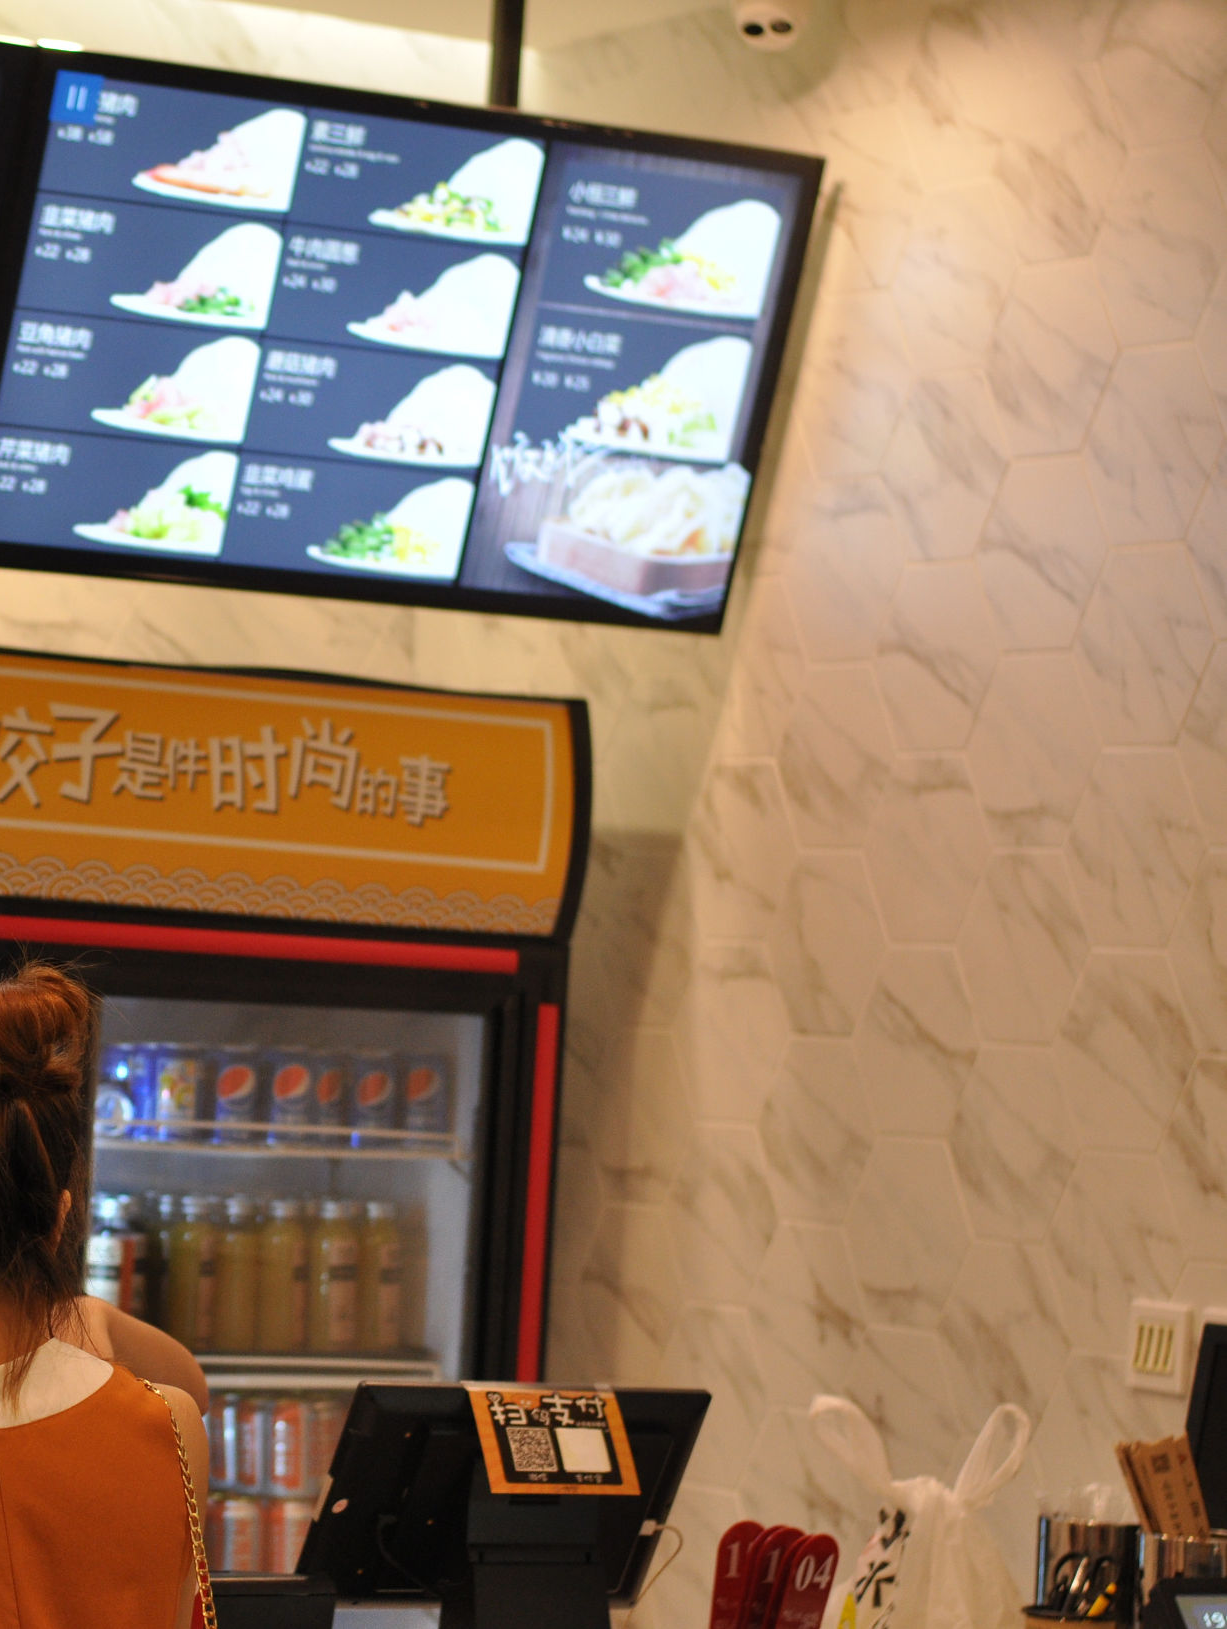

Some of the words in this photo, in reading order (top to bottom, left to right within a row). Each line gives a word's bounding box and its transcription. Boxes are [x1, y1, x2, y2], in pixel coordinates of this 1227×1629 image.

[487, 1392, 604, 1426] 扫码支付
[794, 1553, 835, 1592] 04
[1203, 1611, 1227, 1629] 19
